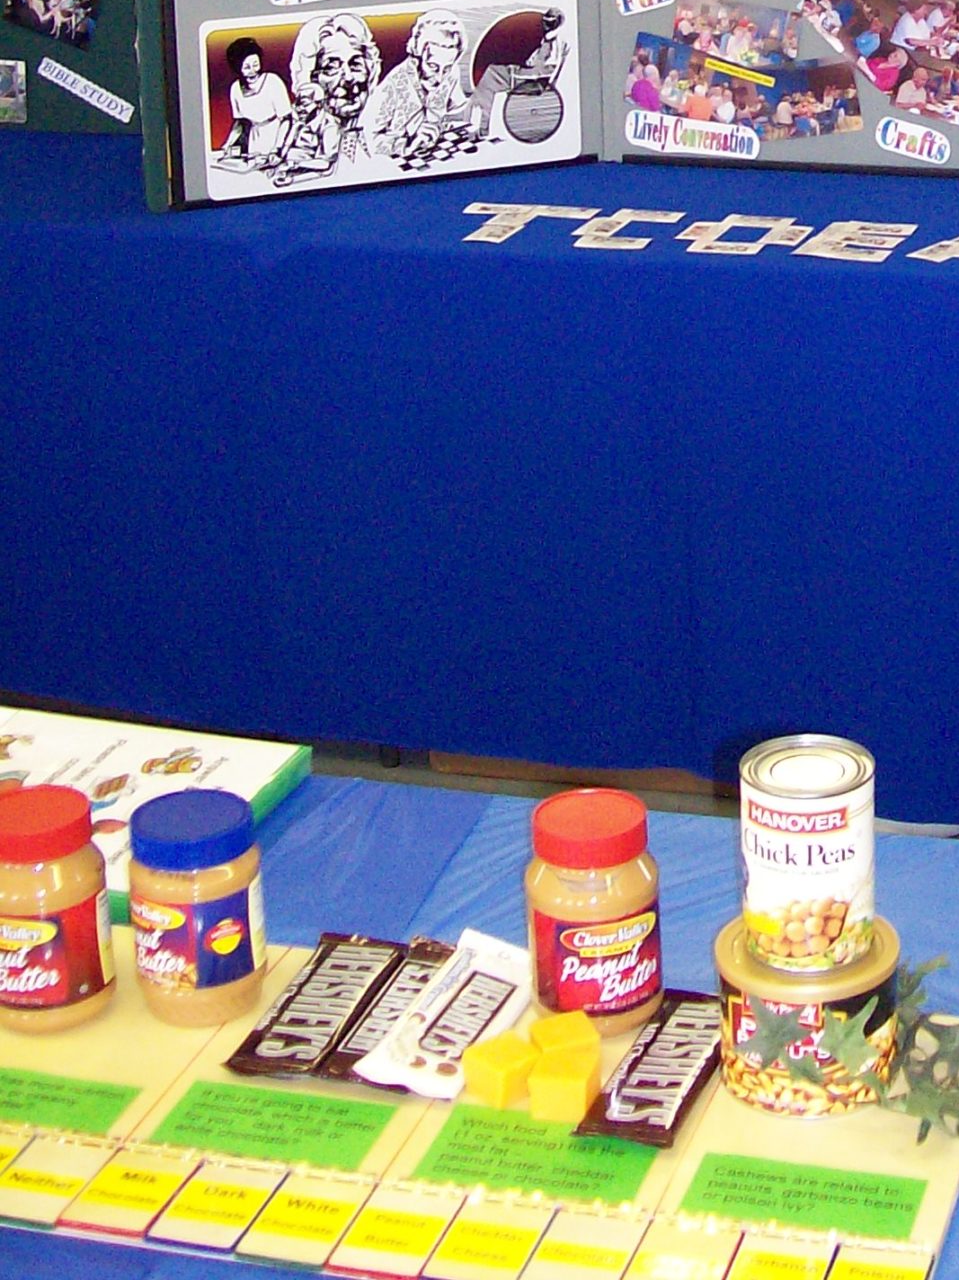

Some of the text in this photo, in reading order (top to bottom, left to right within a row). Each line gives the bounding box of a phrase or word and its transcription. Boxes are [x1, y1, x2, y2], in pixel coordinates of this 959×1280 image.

[41, 61, 131, 116] BIBLE STUDY
[632, 116, 754, 154] Lively Conversation
[880, 117, 948, 162] Crafts
[750, 804, 846, 832] HANOVER
[743, 827, 857, 867] Chick Peas
[573, 930, 614, 947] Clover
[560, 939, 643, 983] Peanut
[599, 956, 658, 1002] Butter
[755, 1253, 820, 1274] arbanzo
